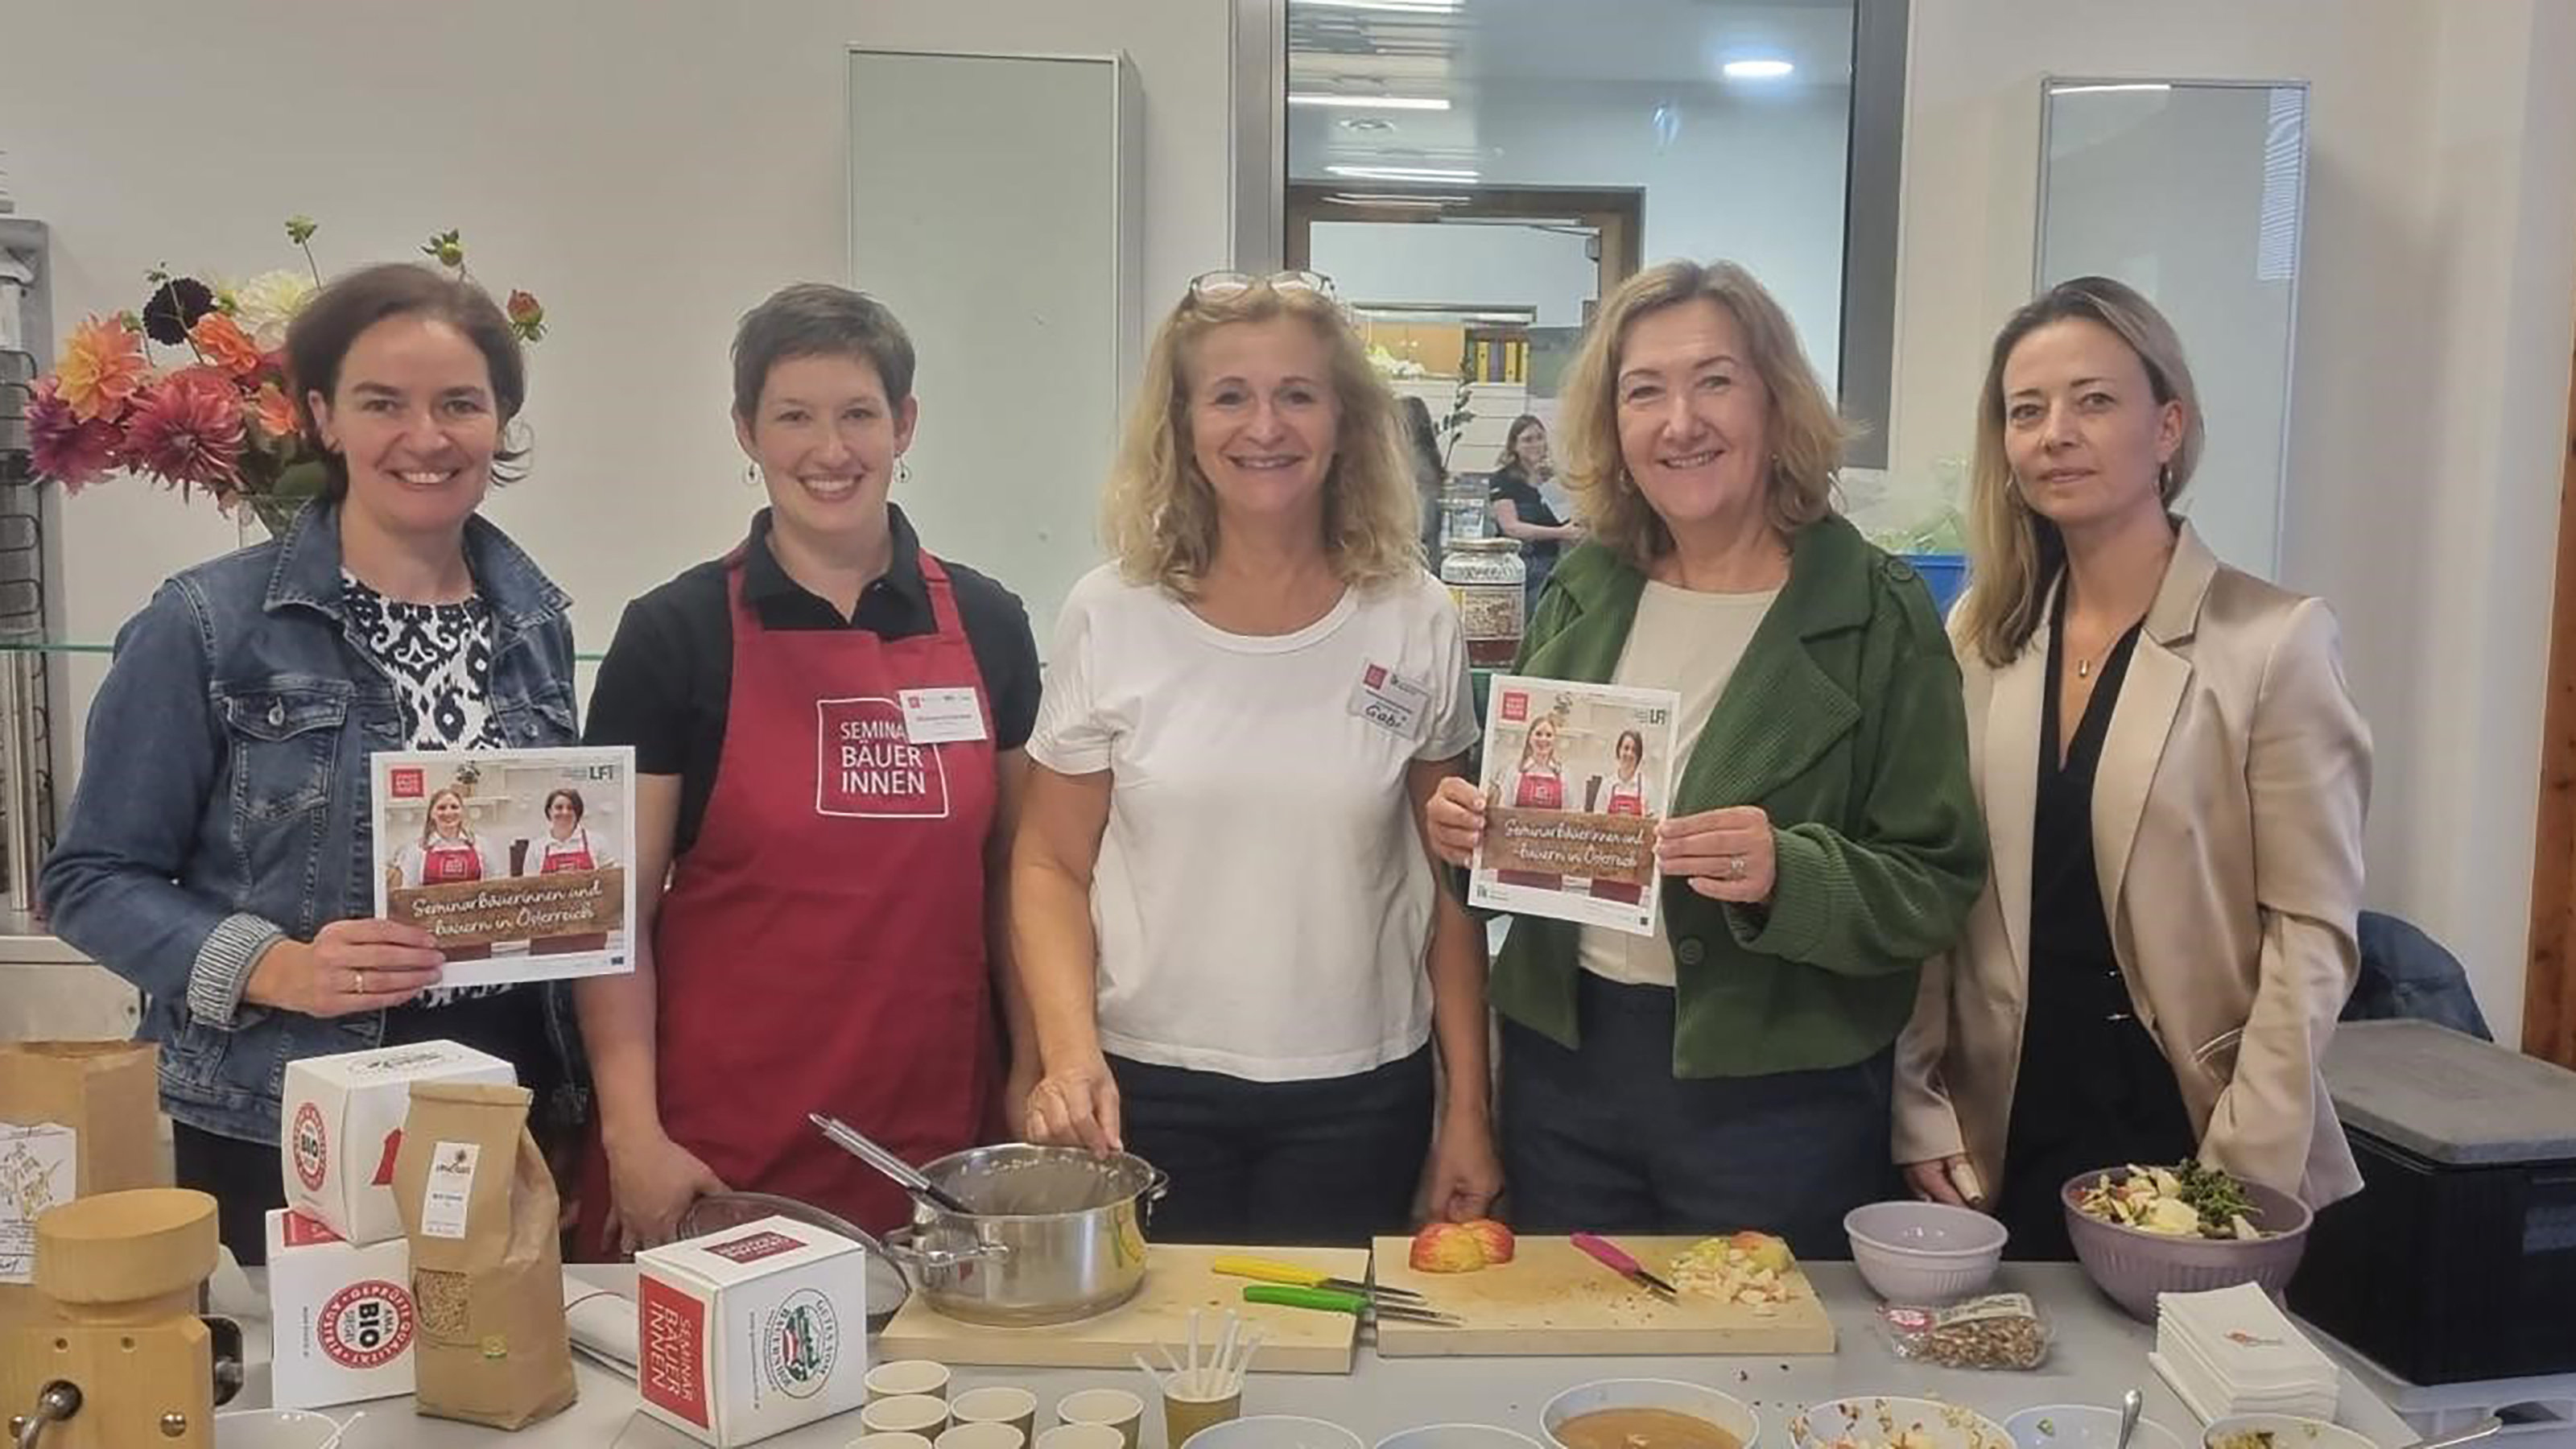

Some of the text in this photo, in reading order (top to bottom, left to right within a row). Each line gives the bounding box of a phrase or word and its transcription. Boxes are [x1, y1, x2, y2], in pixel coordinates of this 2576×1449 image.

[1365, 704, 1407, 727] Gabi
[840, 720, 906, 740] SEMINA
[842, 740, 923, 767] BÄUER
[842, 770, 925, 795] INNEN
[568, 880, 603, 898] und
[495, 917, 511, 928] in
[516, 901, 595, 926] Österreich
[359, 1302, 379, 1348] BIO
[383, 1308, 394, 1335] AMA
[650, 1301, 666, 1389] INNEN
[679, 1315, 693, 1402] SEMINAR
